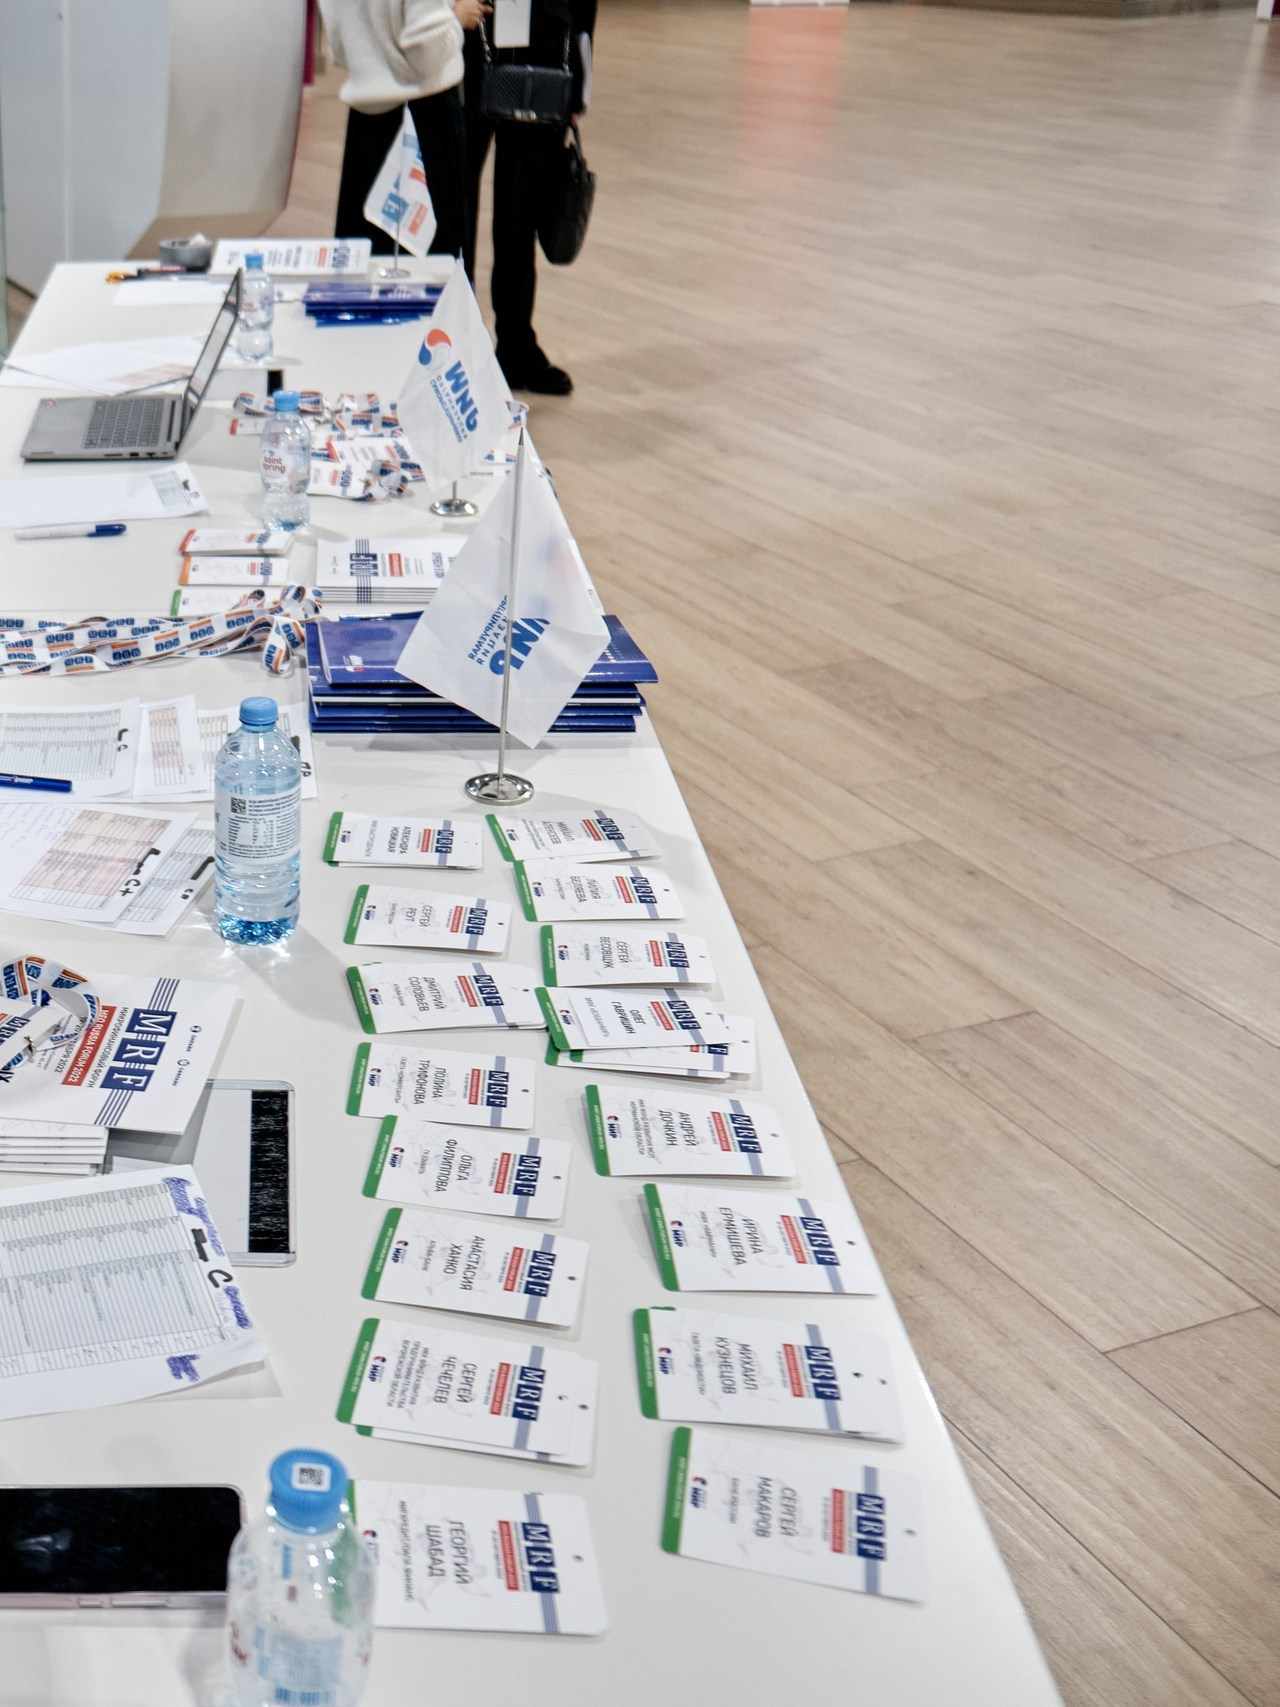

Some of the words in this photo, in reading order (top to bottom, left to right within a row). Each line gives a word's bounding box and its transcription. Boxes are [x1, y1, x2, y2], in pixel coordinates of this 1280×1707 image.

[387, 827, 399, 852] НОВИЦКАЯ
[435, 830, 454, 853] MRF
[542, 821, 561, 844] АЛЕКСЕЕВ
[596, 818, 624, 840] MRF
[570, 876, 587, 902] БЕЛЯЕВА
[586, 879, 601, 899] ЛИЛИЯ
[631, 877, 657, 903] MRF
[406, 908, 416, 922] РЕУТ
[419, 905, 432, 926] СЕРГЕЙ
[466, 908, 487, 935] MRF
[600, 937, 614, 968] ВЕСОВЩУК
[616, 941, 631, 963] СЕРГЕЙ
[665, 942, 689, 968] MRF
[409, 977, 430, 1011] СОЛОВЬЕВ
[423, 977, 447, 1009] ДМИТРИЙ
[473, 975, 504, 1006] MRF
[611, 1002, 635, 1034] ГАВРИШИН
[630, 1010, 646, 1024] ОЛЕГ
[667, 1001, 701, 1029] MRF
[86, 1024, 103, 1045] RUSSIA
[96, 1007, 129, 1068] МИКРОФИНАНСОВЫЙ
[106, 1010, 175, 1089] MRF
[55, 1059, 69, 1073] 2022
[77, 1046, 93, 1067] FORUM
[68, 1067, 82, 1082] 2022
[86, 1070, 101, 1088] ФОРУМ
[414, 1060, 430, 1104] ТРИФОНОВА
[432, 1067, 446, 1097] ПОЛИНА
[487, 1071, 509, 1107] MRF
[658, 1110, 677, 1145] ДОЧКИН
[678, 1112, 699, 1146] АНДРЕЙ
[730, 1114, 762, 1153] MRF
[389, 1154, 399, 1167] МИР
[435, 1139, 458, 1192] ФИЛИППОВА
[456, 1155, 472, 1180] ОЛЬГА
[513, 1155, 541, 1196] MRF
[719, 1207, 746, 1265] ЕРМИШЕВА
[742, 1219, 763, 1254] ИРИНА
[800, 1217, 840, 1266] MRF
[444, 1244, 463, 1274] ХАНКО
[460, 1236, 485, 1290] АНАСТАСИЯ
[524, 1250, 556, 1297] MRF
[434, 1357, 458, 1404] ЧЕЧЕЛЕВ
[715, 1337, 736, 1394] КУЗНЕЦОВ
[738, 1343, 758, 1390] МИХАИЛ
[805, 1346, 841, 1400] MRF
[456, 1363, 478, 1402] СЕРГЕЙ
[512, 1366, 546, 1421] MRF
[754, 1477, 773, 1537] МАКАРОВ
[779, 1487, 799, 1536] СЕРГЕЙ
[856, 1493, 886, 1560] MRF
[425, 1525, 446, 1577] ШАБАД
[449, 1521, 473, 1584] ГЕОРГИЙ
[522, 1523, 560, 1593] MRF
